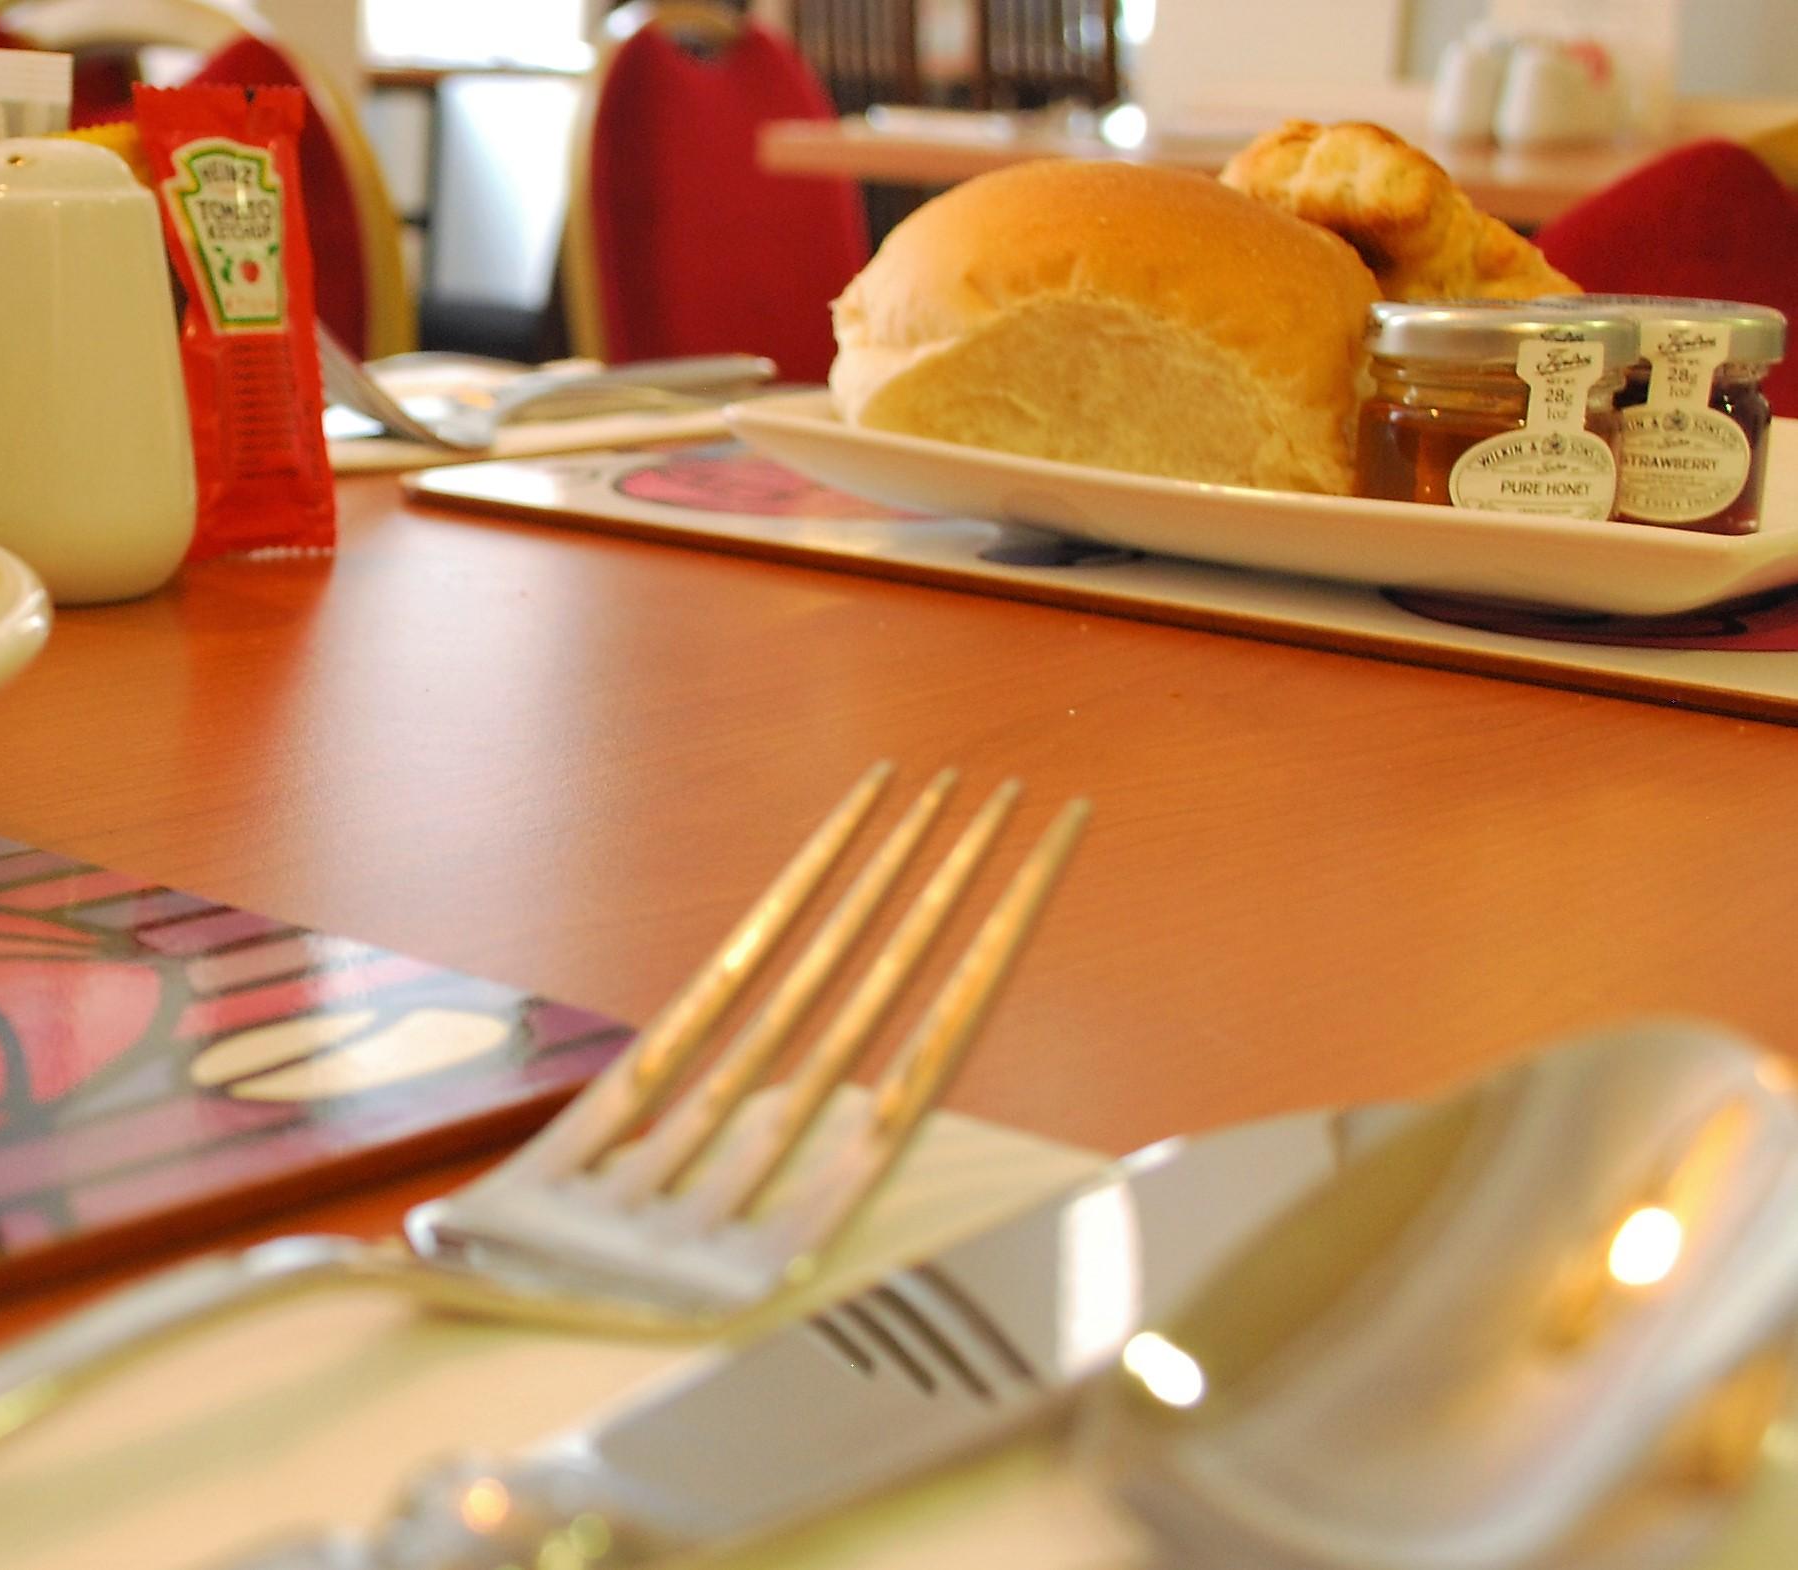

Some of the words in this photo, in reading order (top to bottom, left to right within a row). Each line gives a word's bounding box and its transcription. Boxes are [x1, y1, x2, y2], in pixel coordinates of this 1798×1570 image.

[1667, 367, 1698, 385] 28g
[1545, 388, 1573, 406] 28g
[1478, 443, 1523, 468] WILKIN
[1500, 480, 1542, 496] PURE
[1546, 480, 1592, 496] HONEY
